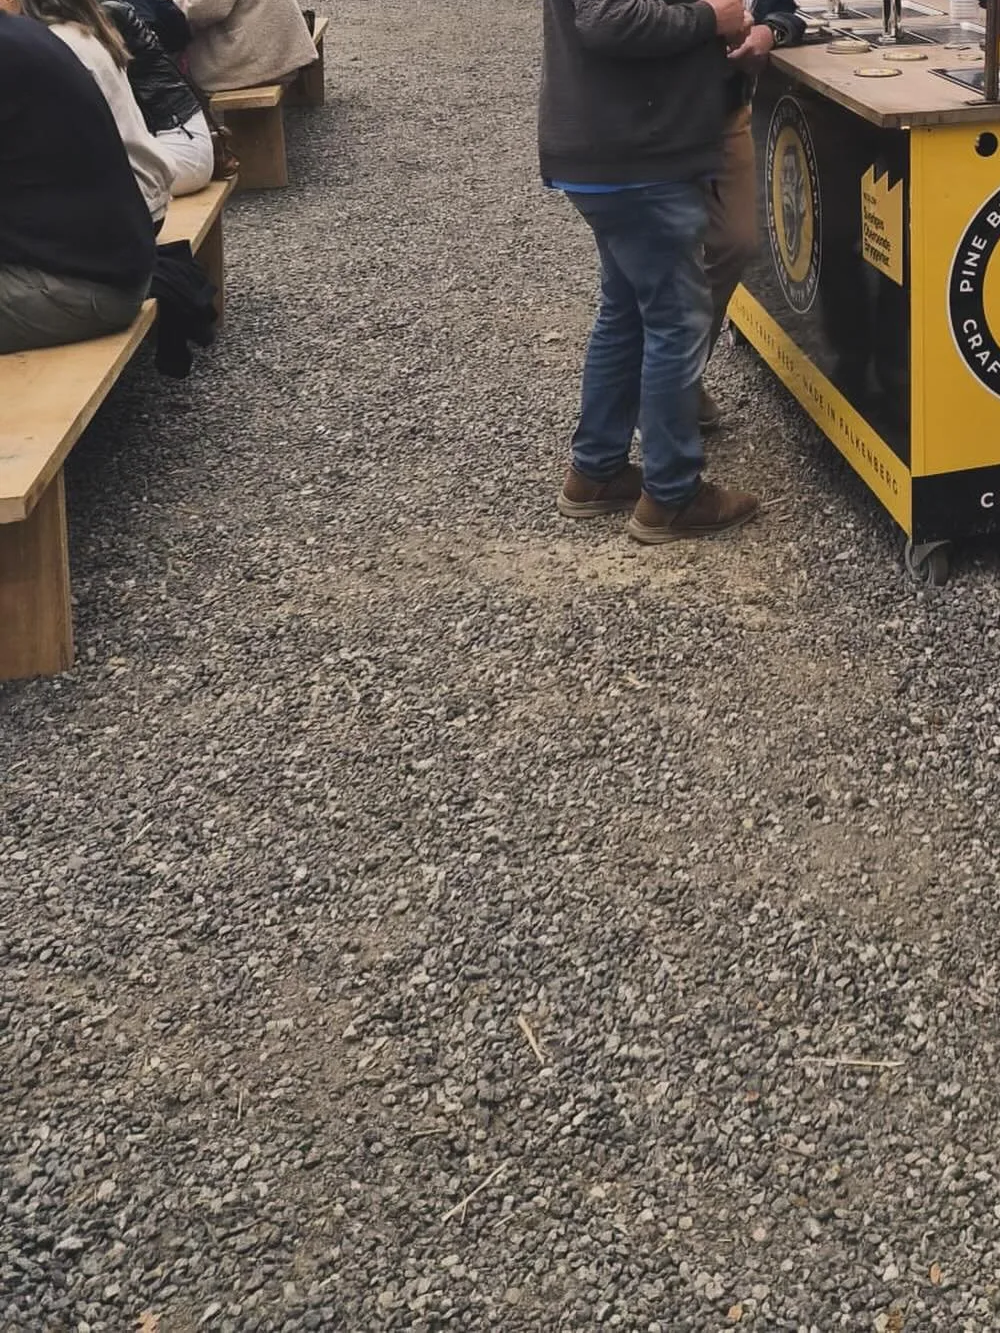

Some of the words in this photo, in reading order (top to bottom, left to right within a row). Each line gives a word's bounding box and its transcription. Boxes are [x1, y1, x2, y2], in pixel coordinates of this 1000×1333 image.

[959, 234, 988, 292] PINE
[826, 403, 836, 422] IN
[839, 417, 899, 496] FALKENBERG
